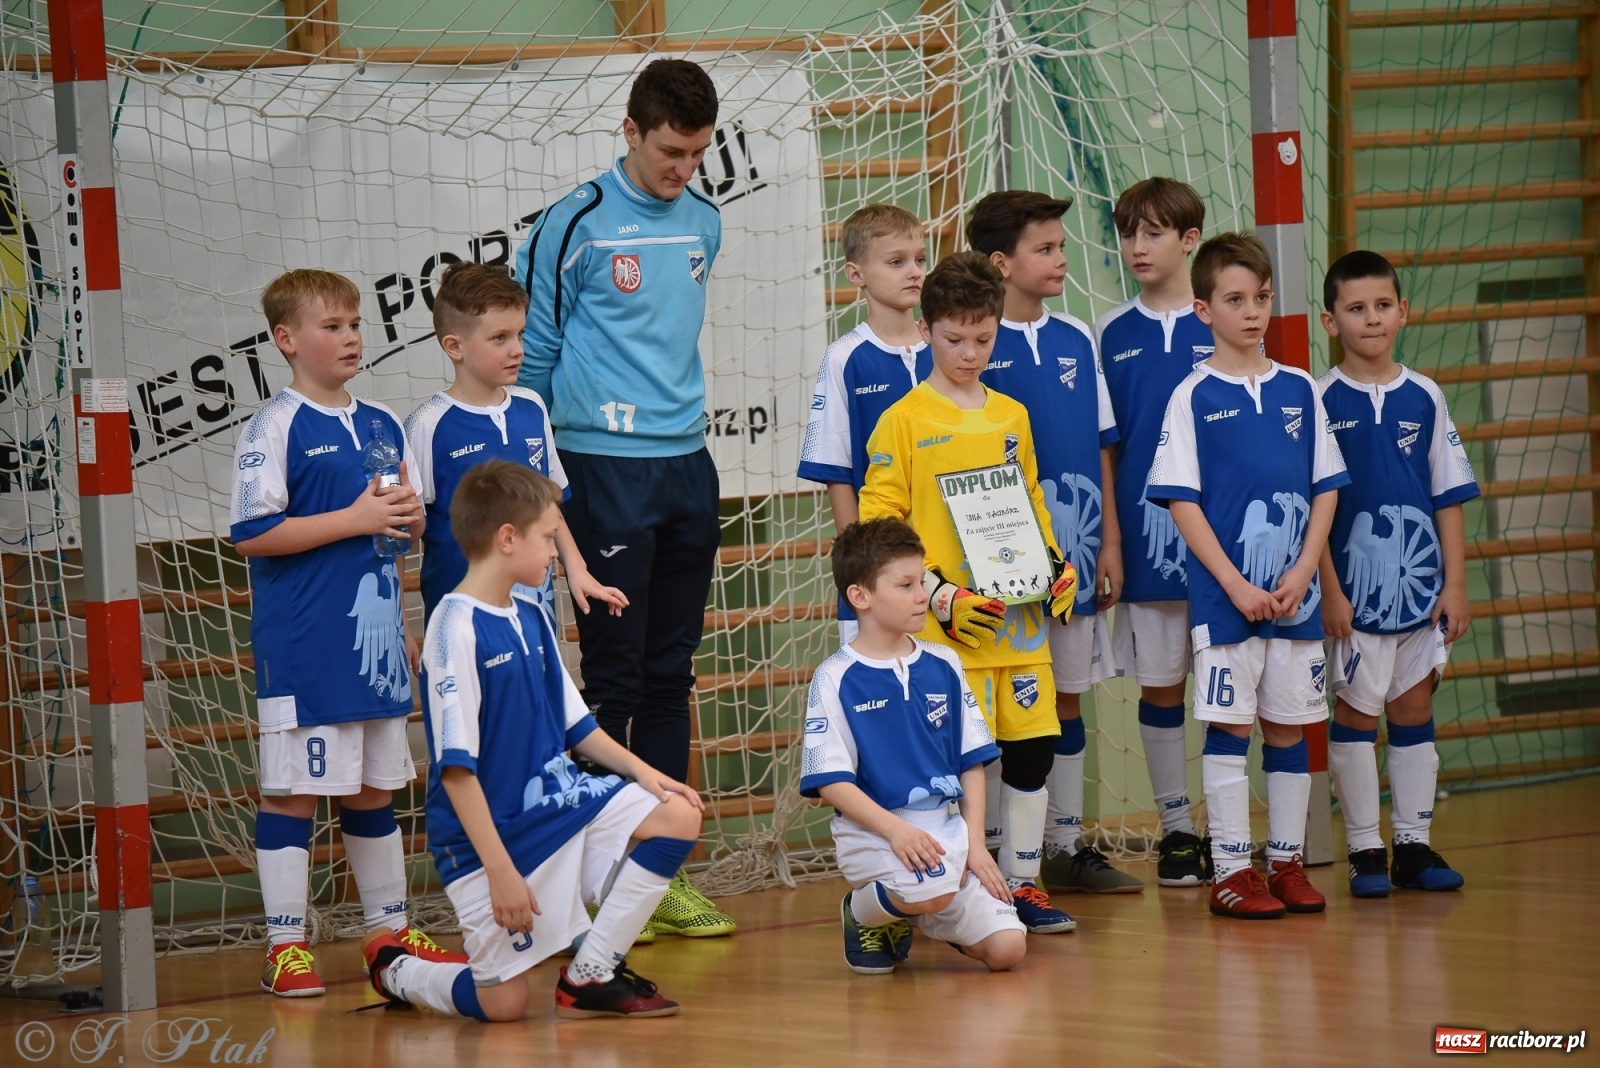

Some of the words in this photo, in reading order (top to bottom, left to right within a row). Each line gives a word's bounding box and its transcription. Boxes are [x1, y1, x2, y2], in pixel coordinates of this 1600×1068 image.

[618, 224, 640, 235] JAKO
[72, 266, 84, 364] sport
[1112, 348, 1143, 362] saller
[853, 383, 890, 395] saller
[600, 401, 636, 433] 17
[1204, 408, 1240, 422] saller
[1286, 419, 1301, 433] UNIA
[917, 433, 953, 449] saller
[1399, 434, 1416, 447] UNIA
[305, 445, 339, 457] saller
[449, 443, 486, 459] saller
[944, 467, 1019, 497] DYPLOM
[1006, 519, 1029, 529] miejsca
[1014, 685, 1036, 700] UNIA
[1206, 666, 1234, 707] 16
[853, 699, 889, 713] saller
[929, 707, 946, 720] UNIA
[307, 737, 326, 778] 8
[266, 914, 303, 926] saller
